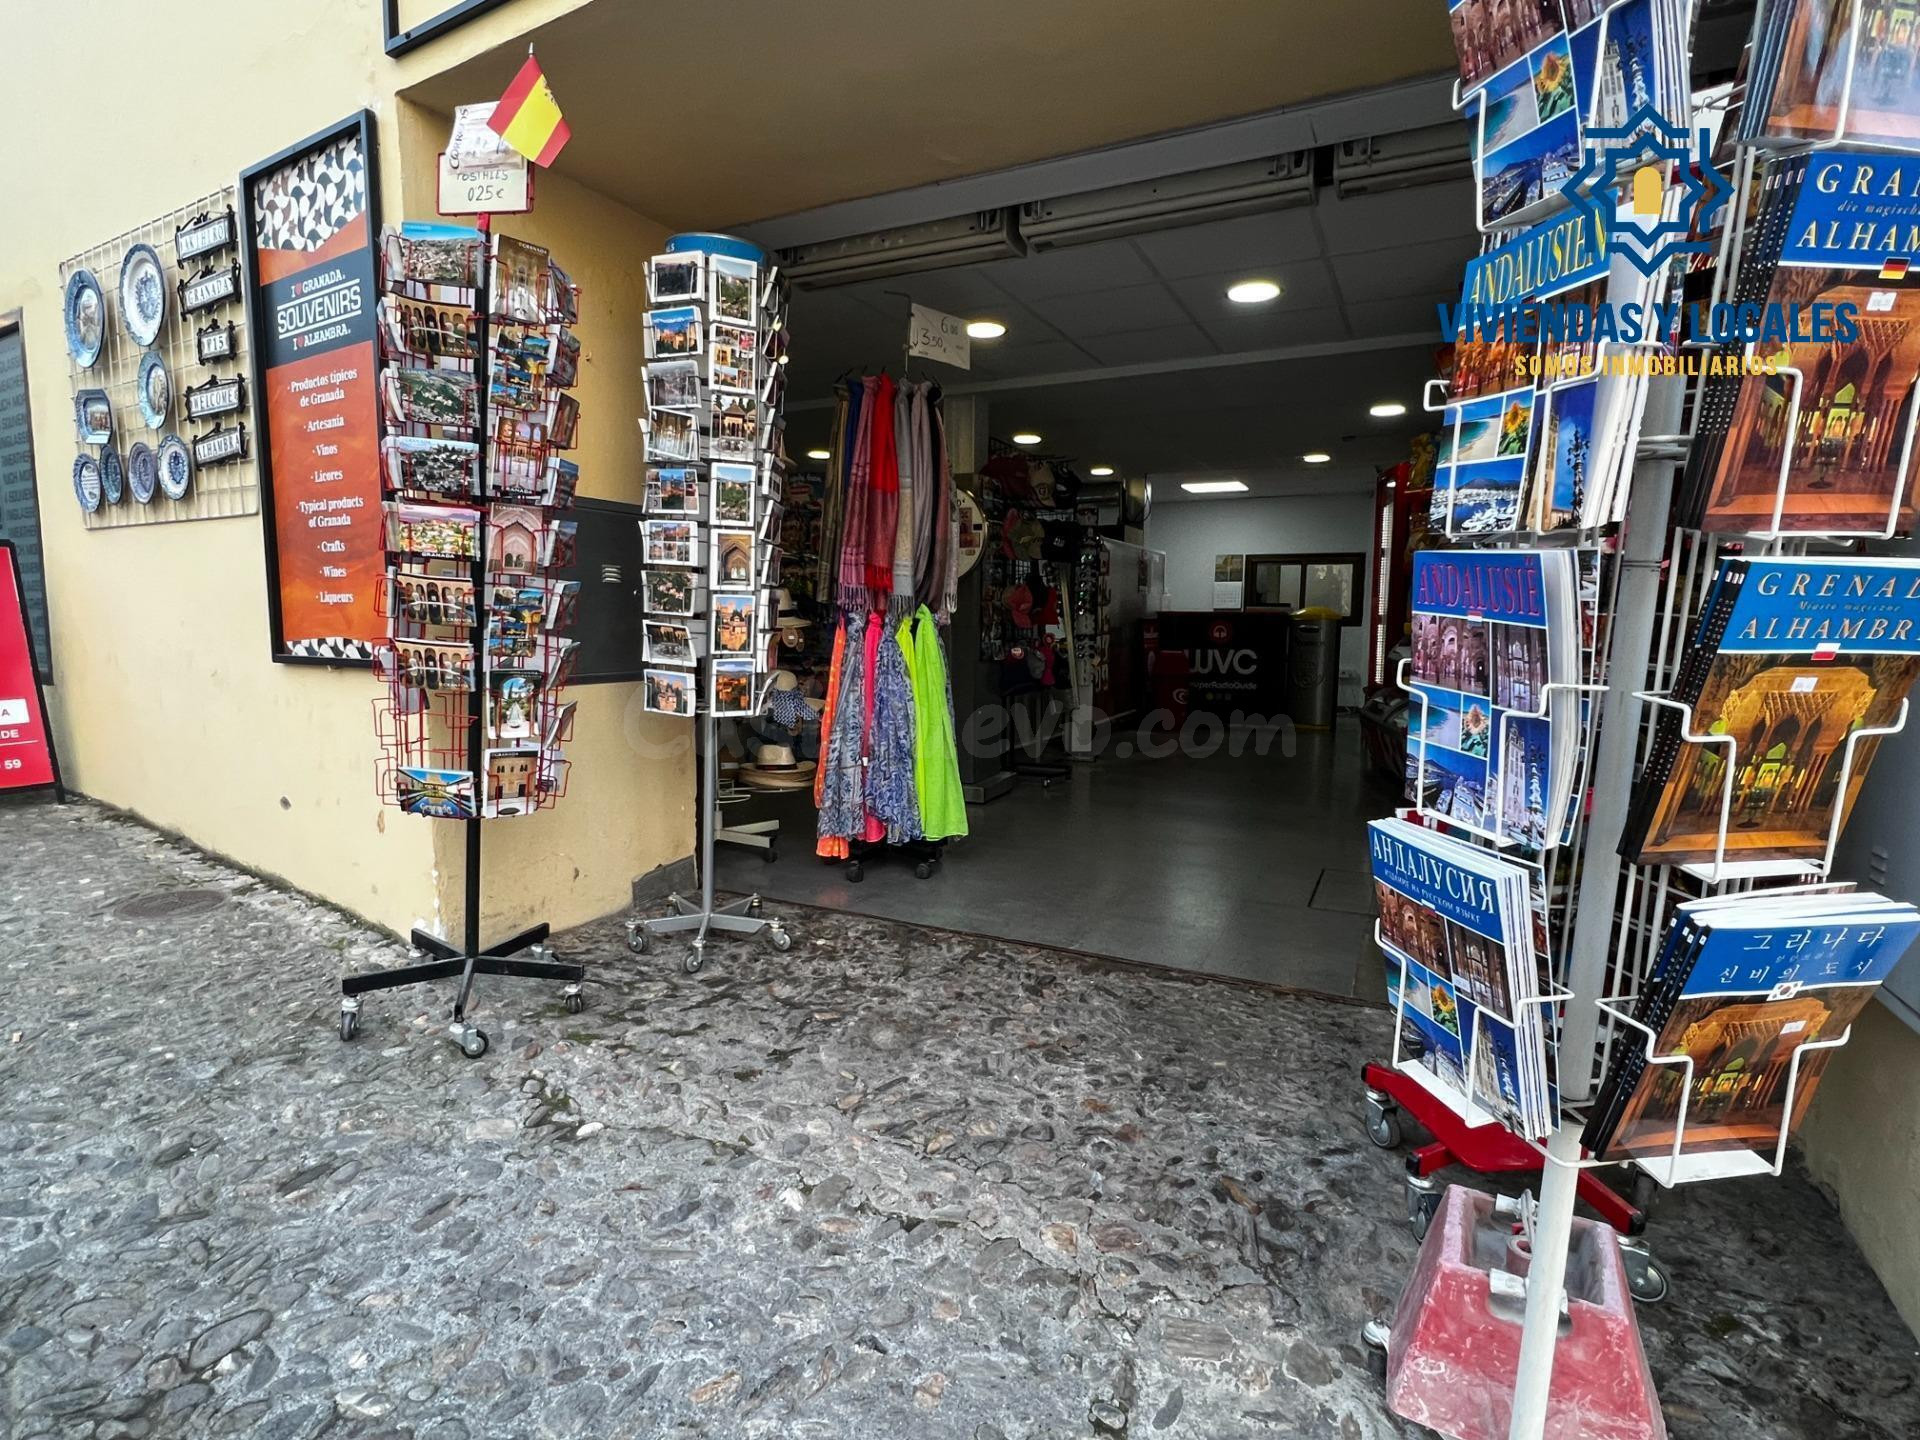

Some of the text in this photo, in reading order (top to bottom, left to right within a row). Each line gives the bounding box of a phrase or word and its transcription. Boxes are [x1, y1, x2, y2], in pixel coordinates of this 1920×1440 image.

[277, 285, 361, 334] SOUVENIRS
[290, 378, 329, 393] Productos
[193, 391, 233, 411] WELCOME
[300, 387, 345, 408] de Granada
[197, 435, 240, 460] ALHAMBRA
[315, 443, 338, 457] Vinos
[314, 469, 343, 483] Licores
[299, 496, 364, 515] Typical products
[308, 513, 352, 528] of Granada
[321, 540, 346, 553] Crafts
[322, 565, 347, 578] Wines
[319, 591, 355, 606] Liqueurs
[1738, 617, 1920, 642] ALHAMBR
[1373, 830, 1495, 914] АНДАЛУСИЯ
